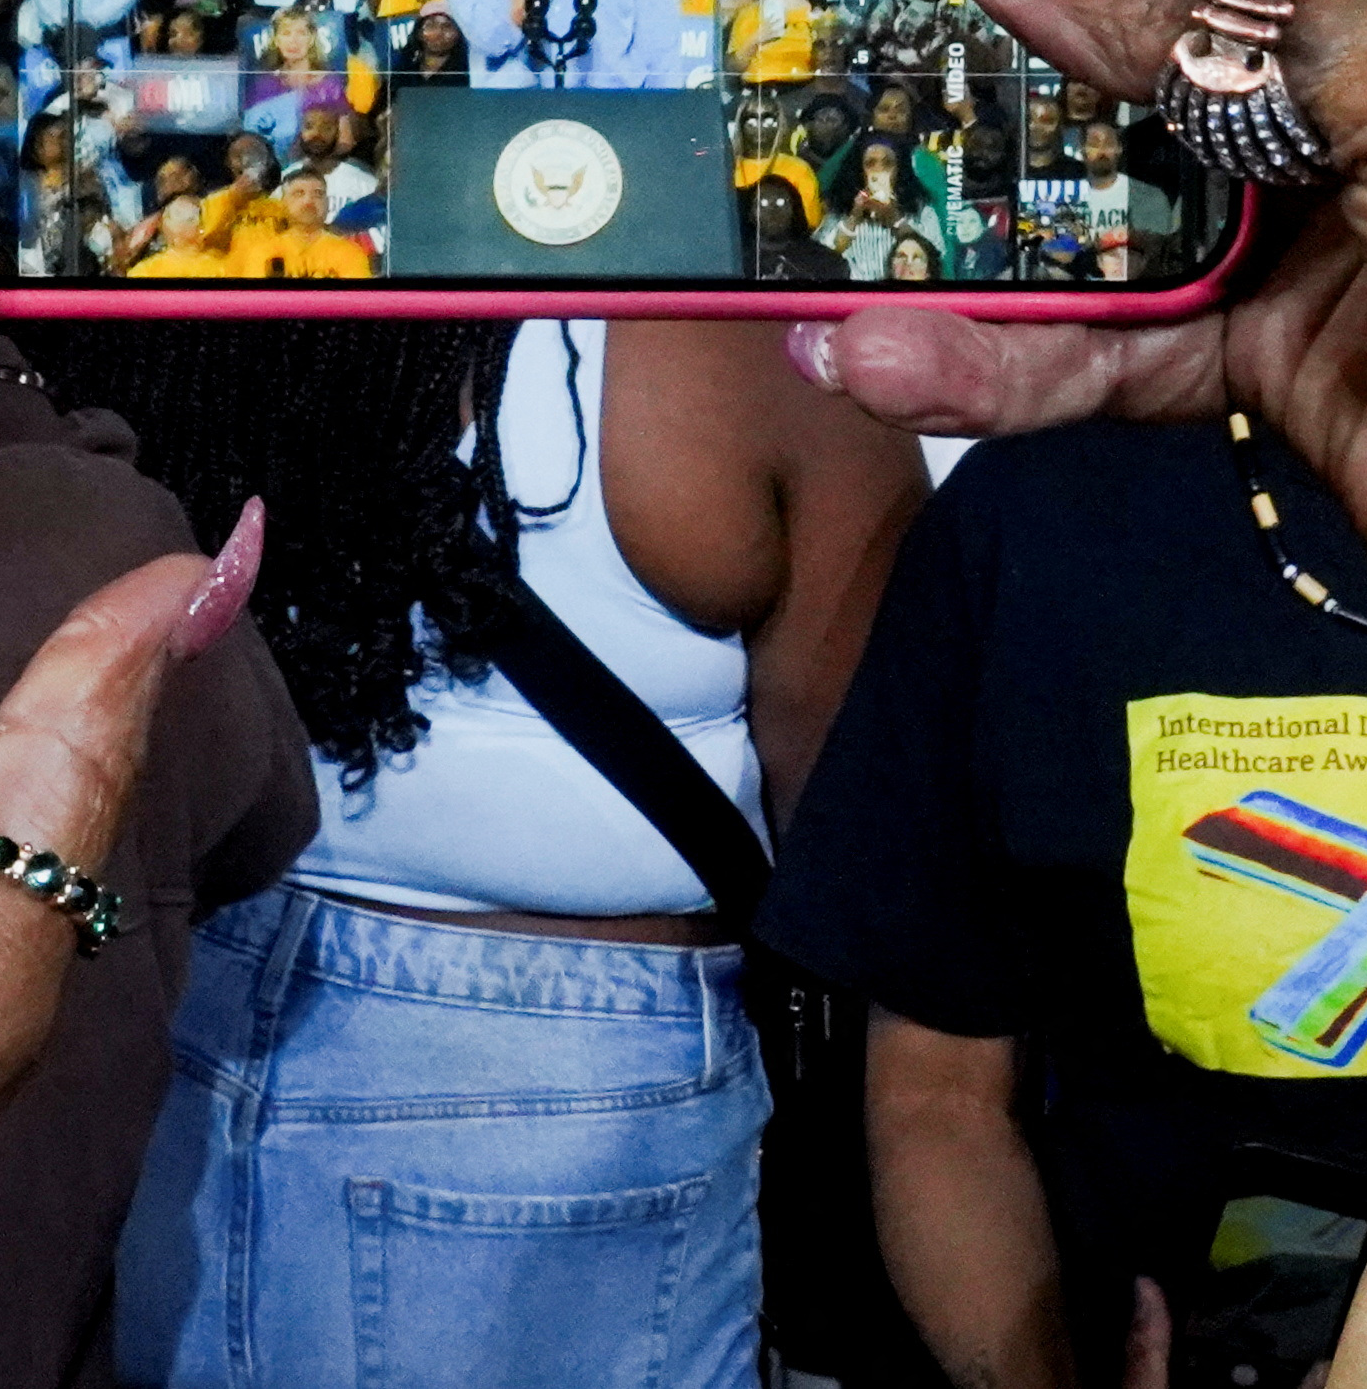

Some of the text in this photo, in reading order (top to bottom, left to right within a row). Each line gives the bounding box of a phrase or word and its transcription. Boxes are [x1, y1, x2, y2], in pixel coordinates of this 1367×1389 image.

[947, 42, 965, 104] VIDEO
[1158, 713, 1349, 738] International
[1156, 747, 1315, 773] Healthcare
